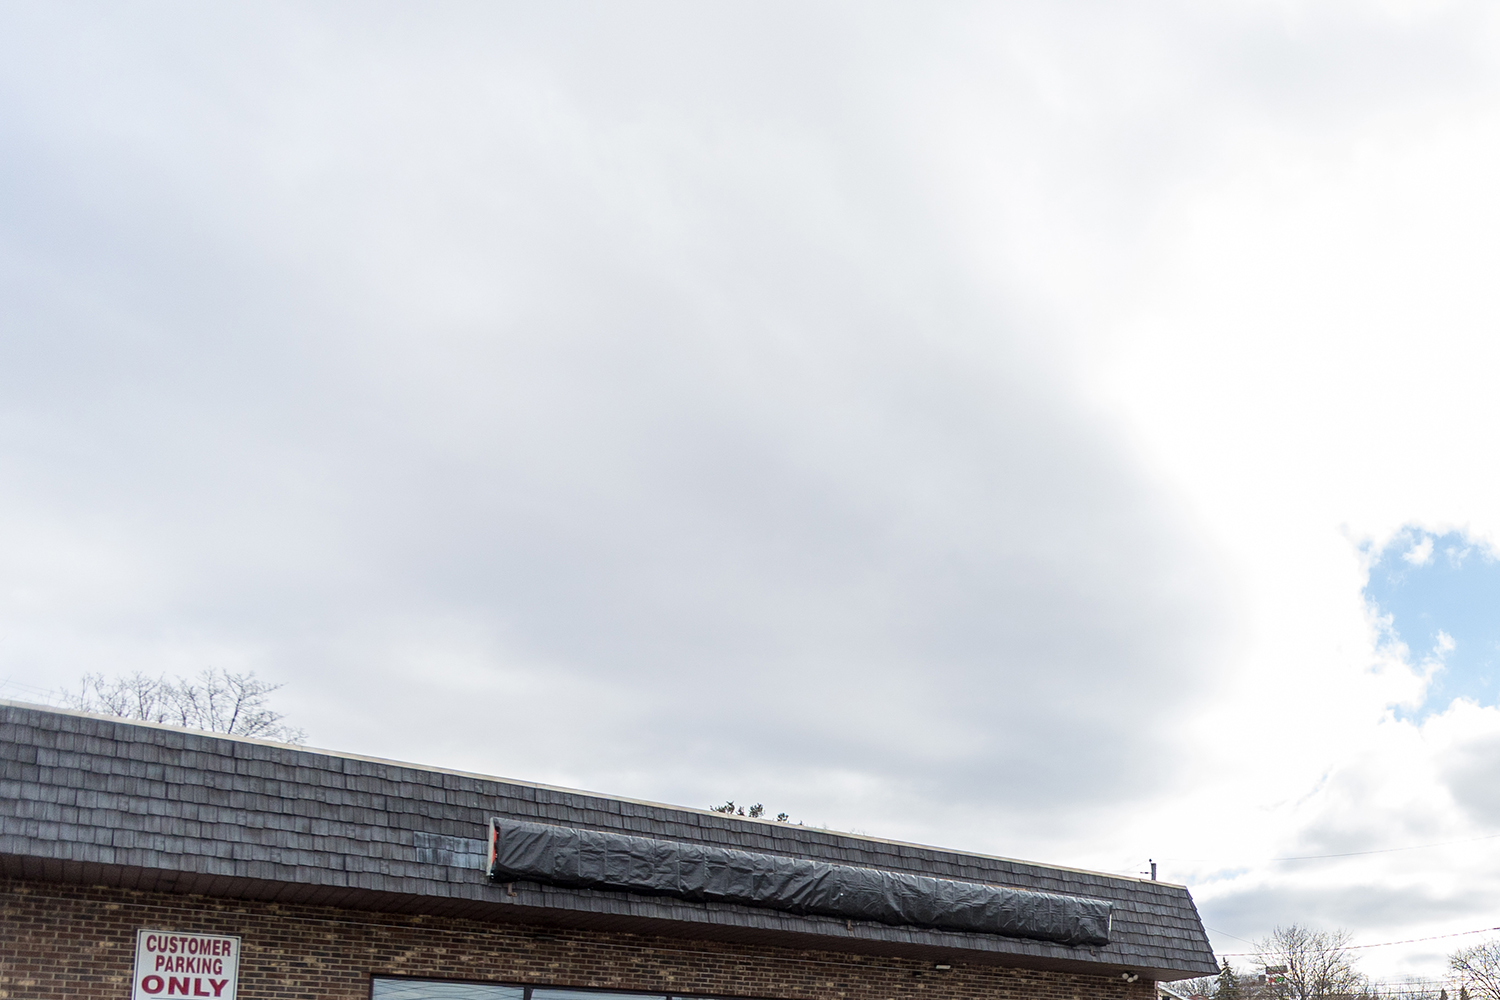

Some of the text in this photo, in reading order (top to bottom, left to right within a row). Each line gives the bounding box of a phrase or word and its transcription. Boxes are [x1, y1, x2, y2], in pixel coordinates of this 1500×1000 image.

[146, 935, 231, 957] CUSTOMER
[155, 955, 223, 975] PARKING
[141, 975, 230, 997] ONLY
